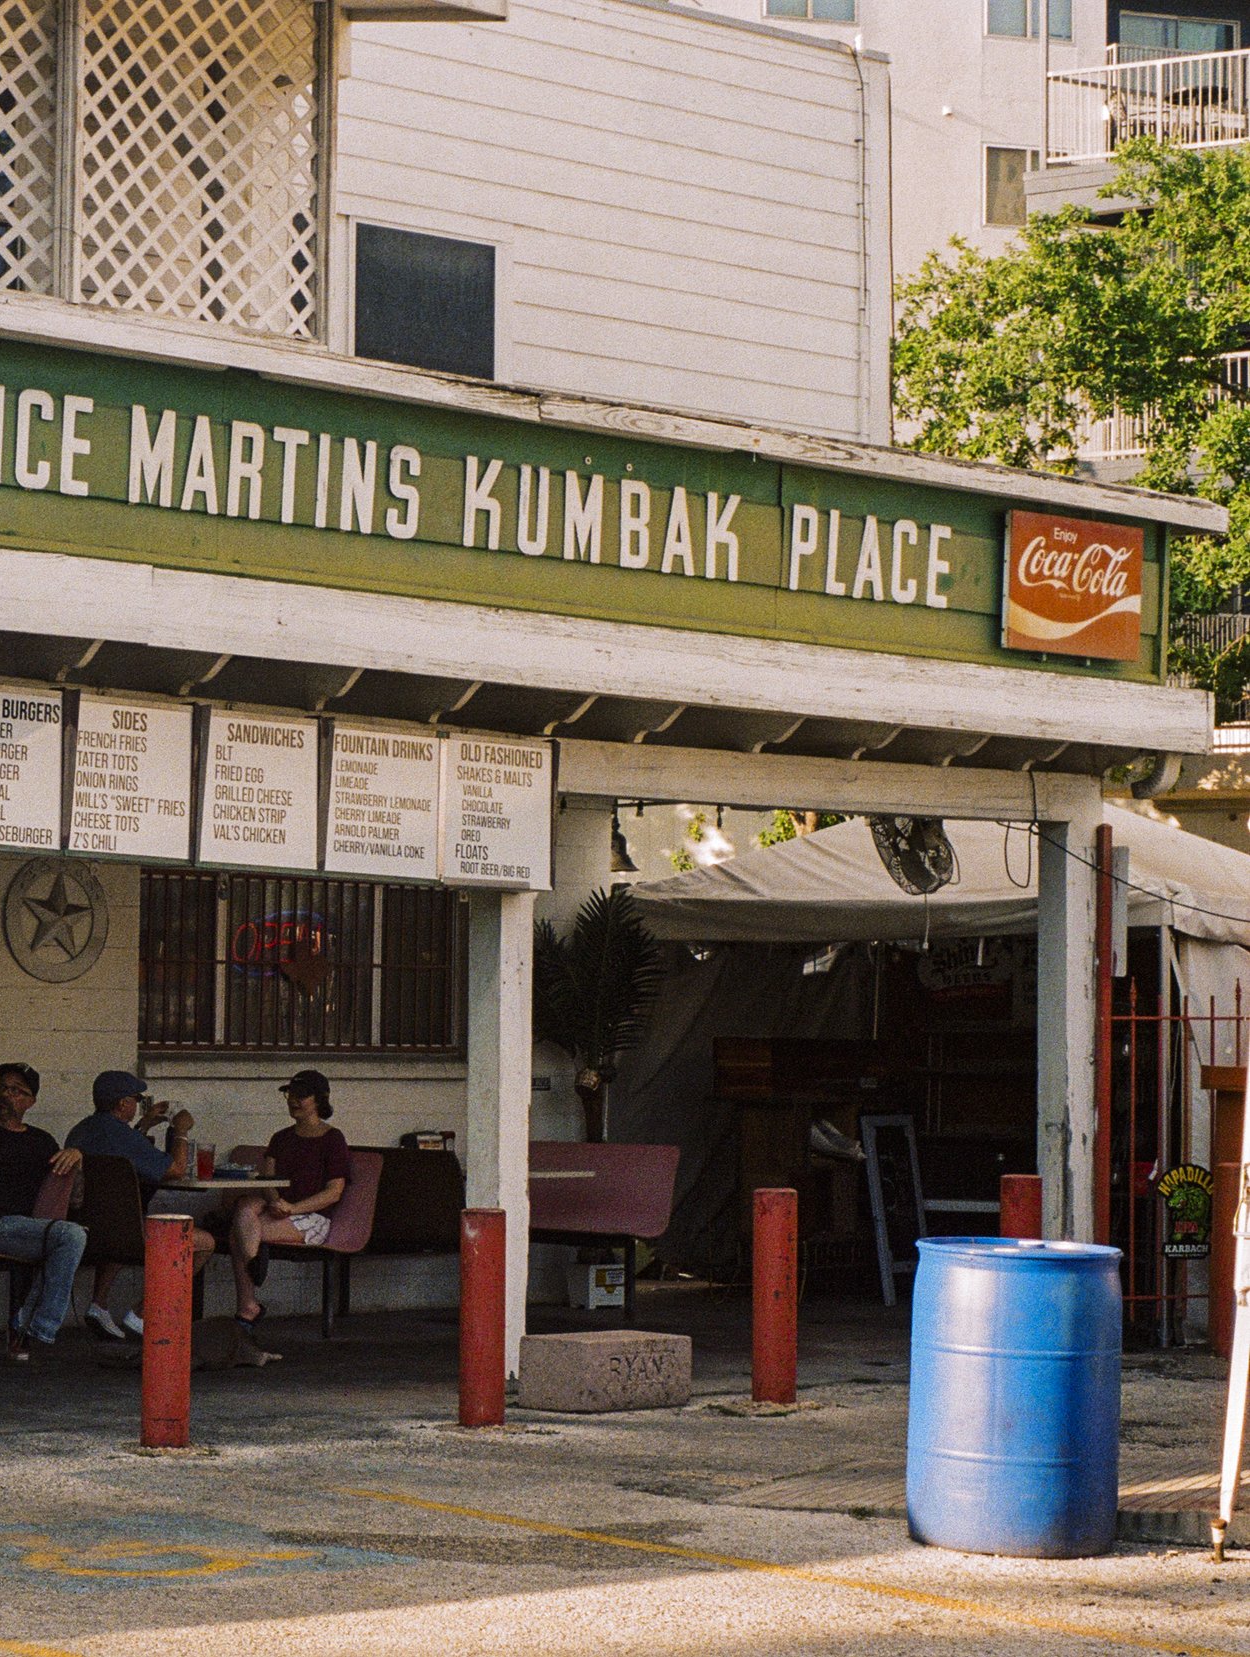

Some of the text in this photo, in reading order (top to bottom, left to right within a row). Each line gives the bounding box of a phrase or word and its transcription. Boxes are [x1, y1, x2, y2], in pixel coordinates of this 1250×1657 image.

[128, 404, 421, 539] MARTINS
[463, 455, 741, 582] KUMBAK
[789, 504, 952, 609] PLACE
[1054, 527, 1078, 544] Enjoy
[1018, 536, 1135, 597] Coca-Cola
[2, 699, 60, 724] BURGERS
[112, 709, 147, 732] SIDES
[78, 730, 147, 753] FRENCH FRIES
[227, 723, 305, 749] SANDWICHES
[216, 744, 234, 761] BLT
[334, 733, 433, 762] FOUNTAIN DRINKS
[461, 743, 543, 769] OLD FASHIONED
[77, 751, 138, 772] TATER TOTS
[336, 759, 378, 775] LEMONADE
[76, 771, 139, 792] ONION RINGS
[215, 765, 264, 784] FRIED EGG
[335, 776, 369, 791] LIMEADE
[457, 766, 493, 784] SHAKES
[504, 771, 533, 787] MALTS
[215, 785, 293, 807] GRILLED CHEESE
[335, 791, 432, 812] STRAWBERRY LEMONADE
[462, 785, 493, 799] VANILLA
[75, 792, 108, 810] WILL'S
[158, 799, 185, 817] FRIES
[213, 804, 287, 824] CHICKEN STRIP
[462, 800, 503, 815] CHOCOLATE
[74, 812, 139, 833] CHEESE TOTS
[335, 807, 401, 825] CHERRY LIMEADE
[462, 814, 511, 830] STRAWBERRY
[74, 833, 116, 851] Z'S CHILI
[213, 824, 286, 844] VAL'S CHICKEN
[335, 824, 400, 840] ARNOLD PALMER
[461, 829, 480, 842] OREO
[404, 846, 425, 859] COKE
[455, 843, 489, 861] FLOATS
[460, 862, 479, 874] ROOT
[516, 867, 530, 878] RED
[1165, 1244, 1208, 1253] KARBACH
[610, 1352, 664, 1381] RYAN
